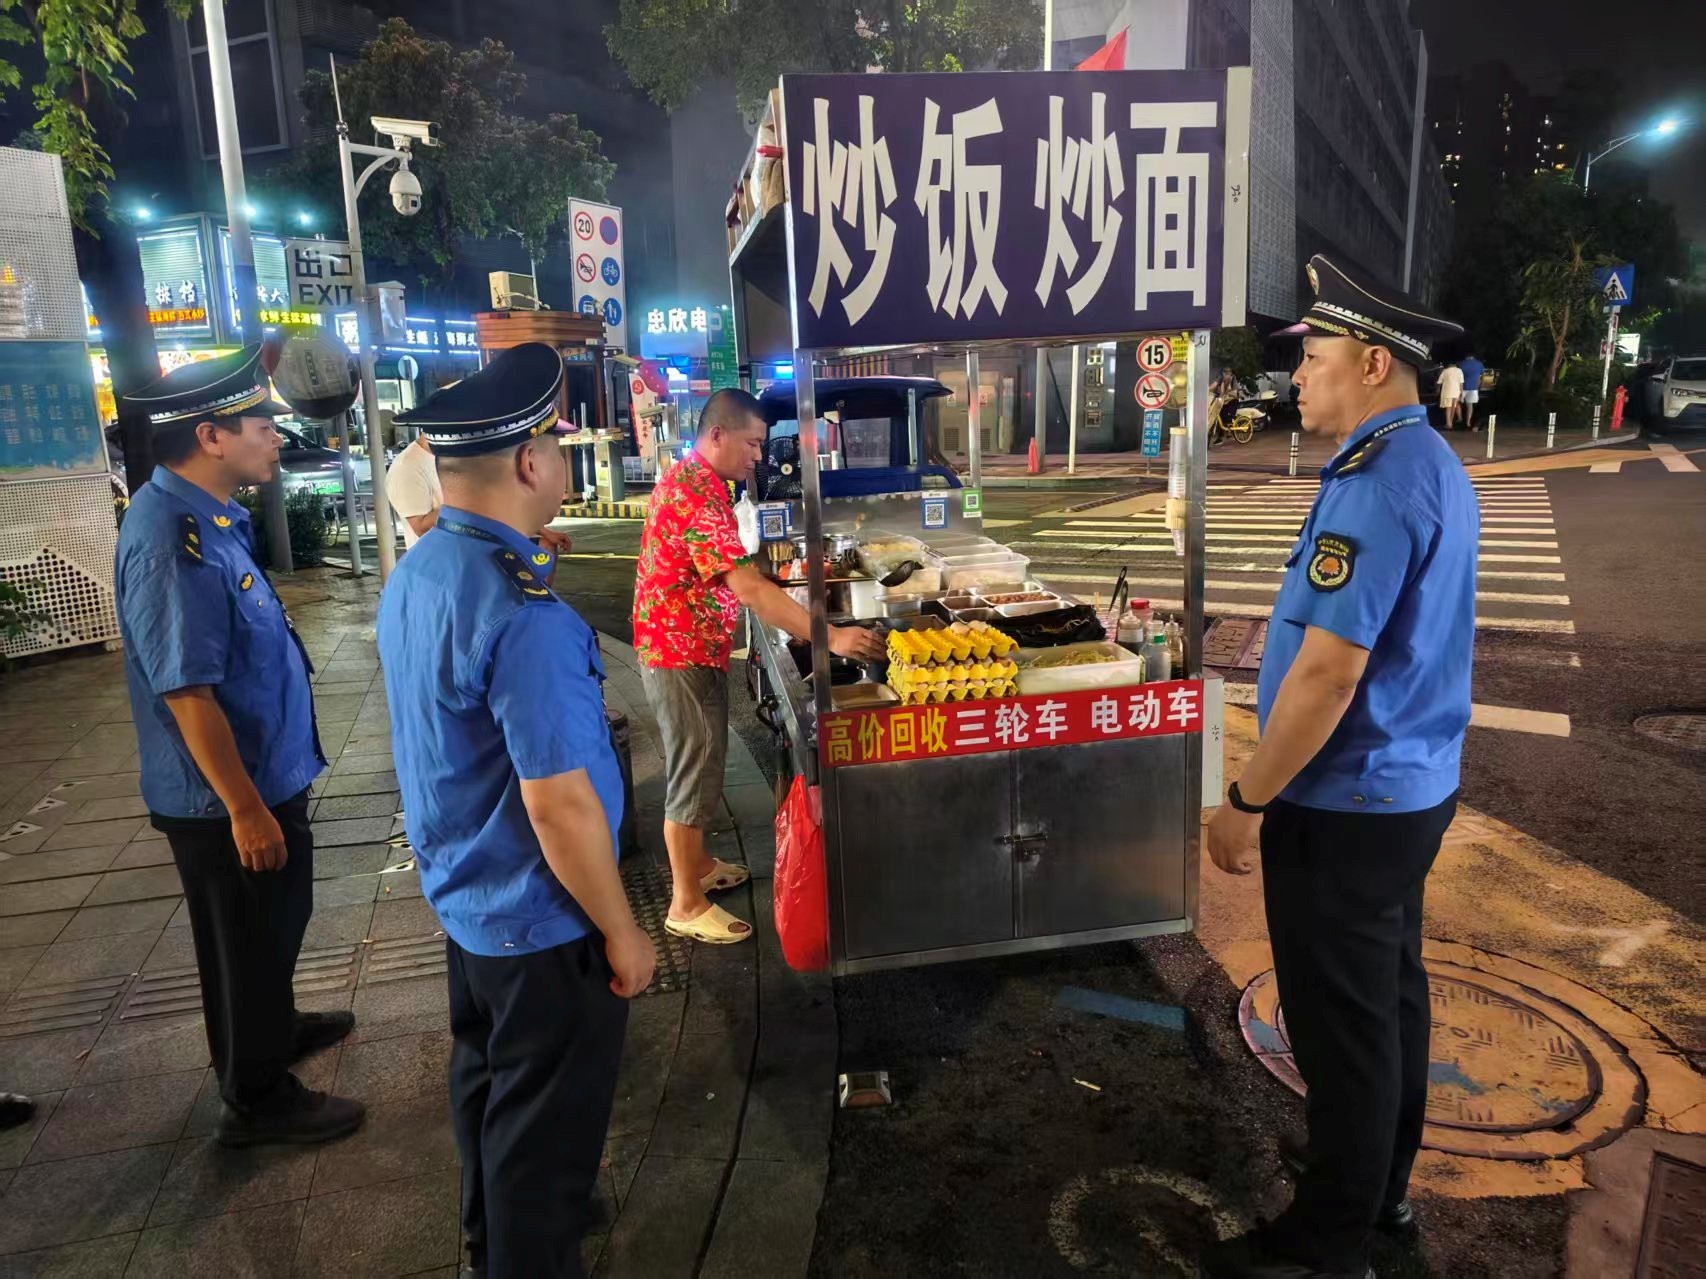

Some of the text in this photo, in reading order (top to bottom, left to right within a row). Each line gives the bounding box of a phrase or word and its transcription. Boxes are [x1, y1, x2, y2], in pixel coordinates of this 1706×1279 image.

[803, 92, 1217, 326] 炒饭炒面
[578, 218, 591, 234] 20
[294, 248, 353, 278] 出口
[298, 283, 353, 305] EXIT
[647, 306, 708, 335] 忠欣电
[1144, 344, 1165, 366] 15
[824, 687, 1200, 763] 高价回收三轮车 电动车
